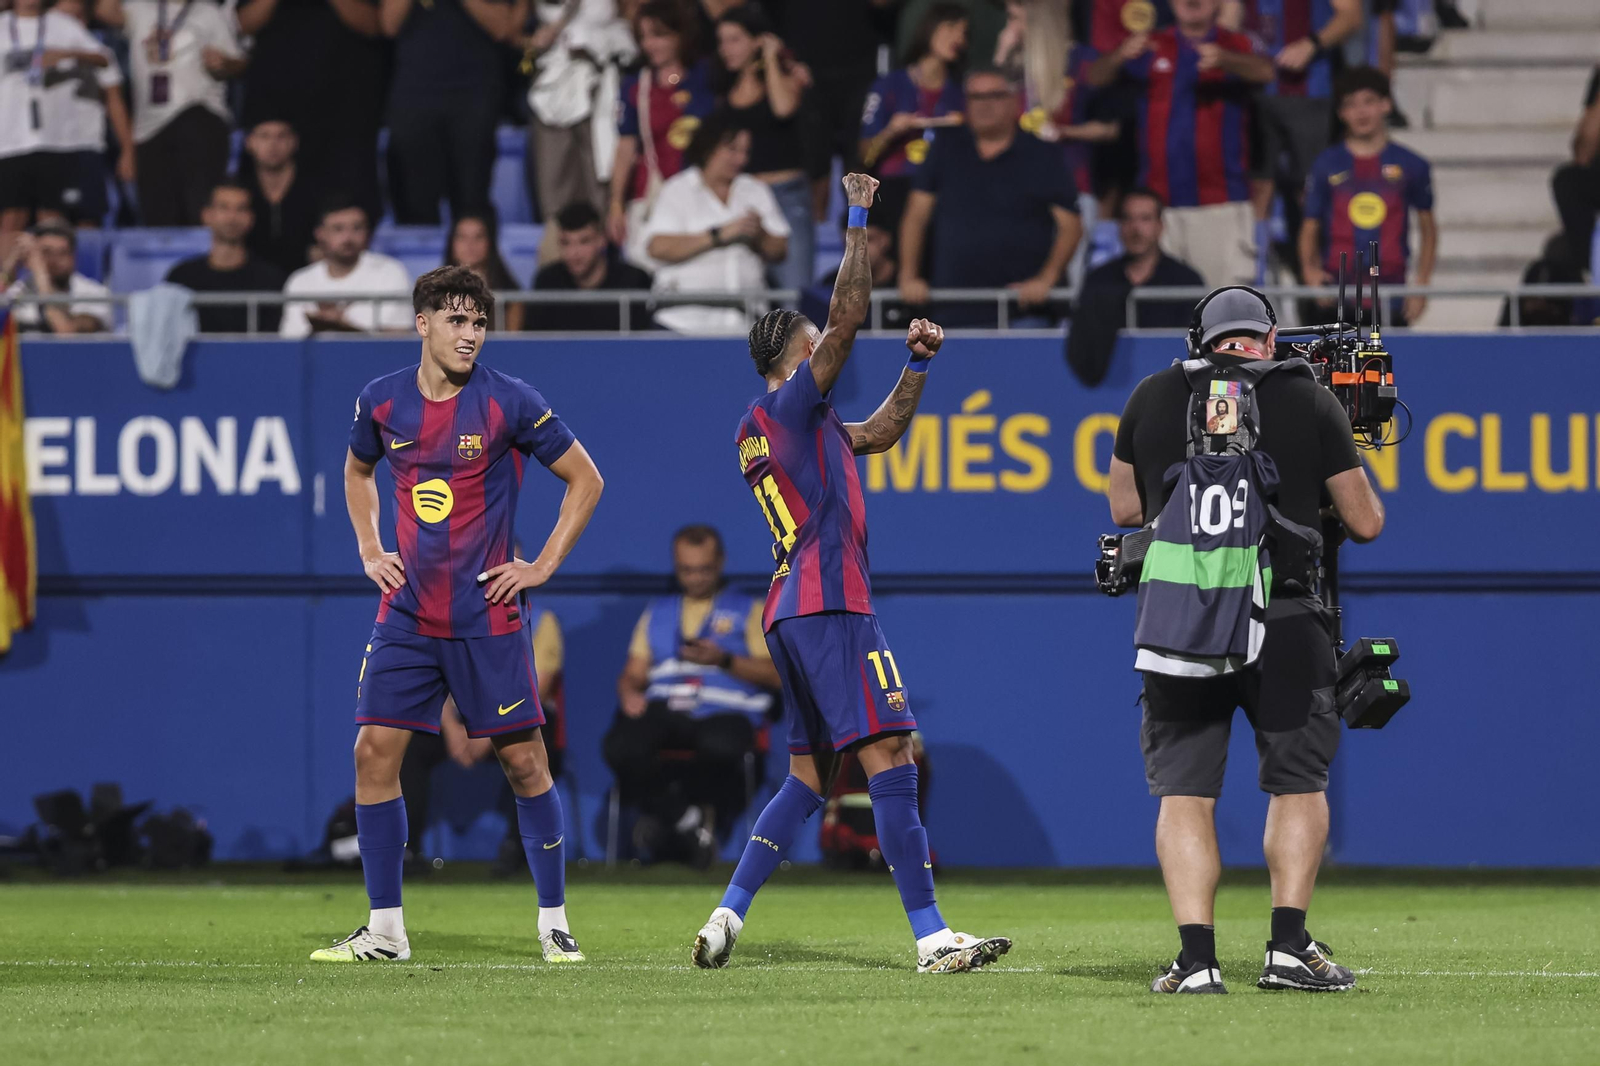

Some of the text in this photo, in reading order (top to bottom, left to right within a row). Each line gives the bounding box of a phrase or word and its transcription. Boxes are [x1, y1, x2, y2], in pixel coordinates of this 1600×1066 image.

[867, 390, 1052, 492] MÉS
[1424, 413, 1600, 493] CLU
[1189, 479, 1248, 535] 109
[868, 650, 903, 689] 11
